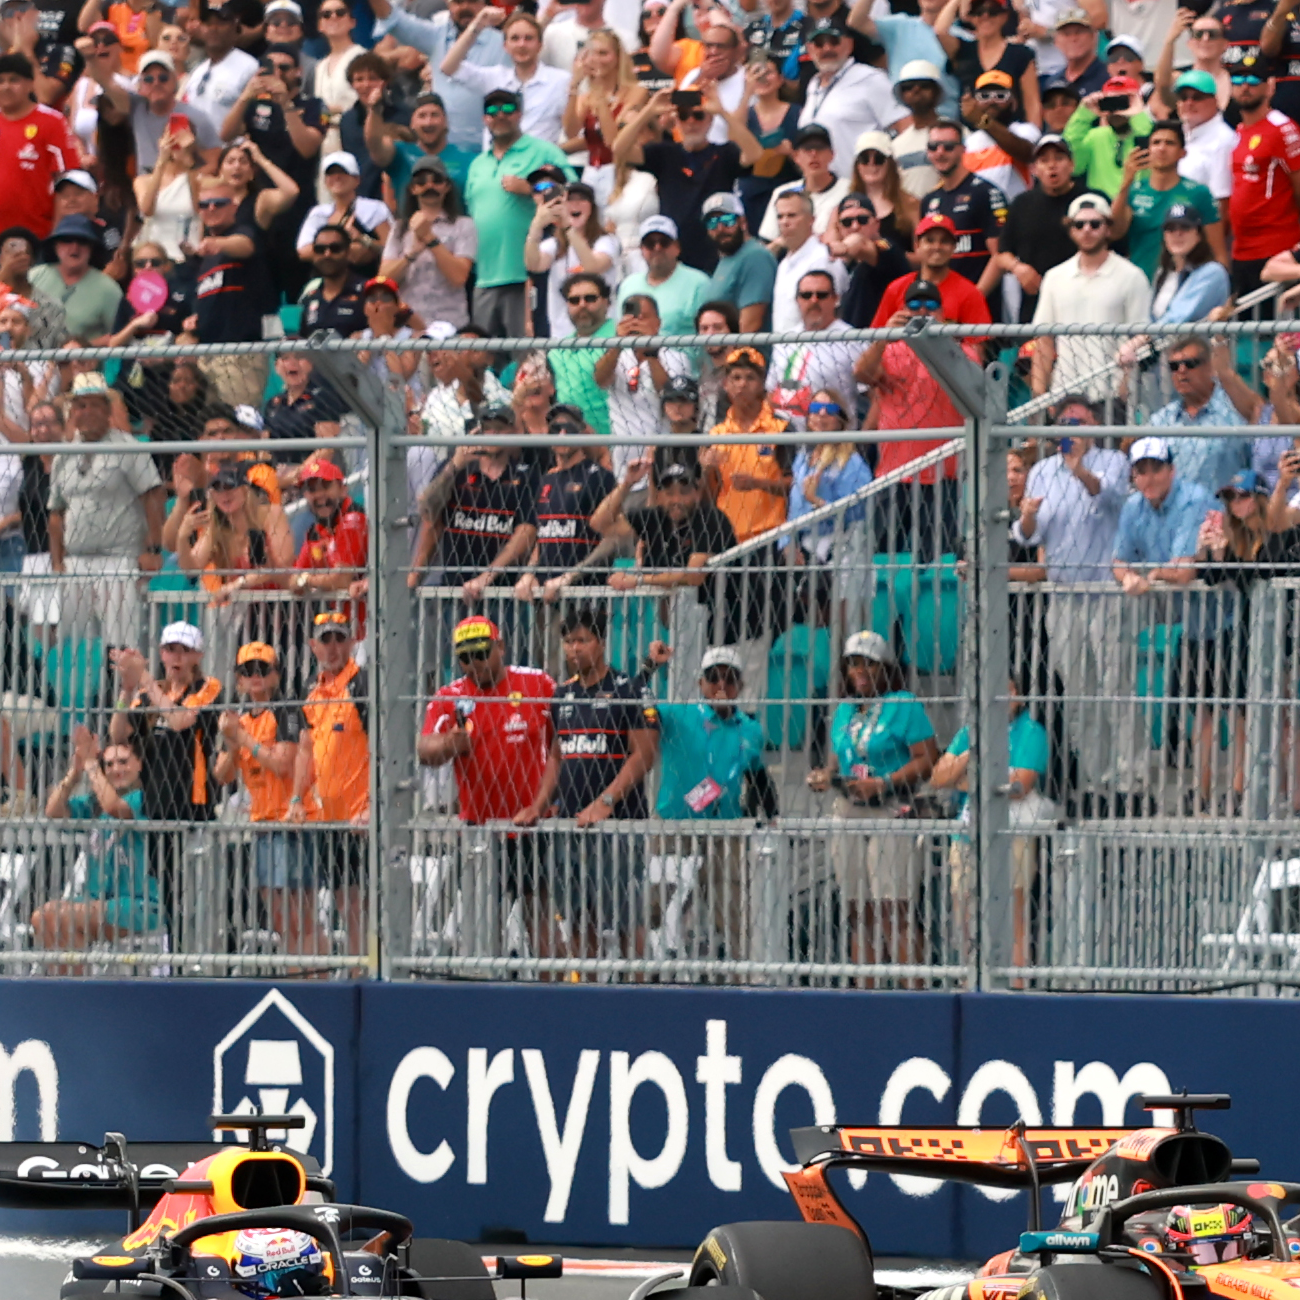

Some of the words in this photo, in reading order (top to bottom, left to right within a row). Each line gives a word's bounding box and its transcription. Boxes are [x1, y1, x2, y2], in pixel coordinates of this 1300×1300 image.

[454, 512, 486, 531] Red
[576, 734, 607, 754] Bull
[386, 1019, 1175, 1225] crypto.com
[1026, 1139, 1117, 1158] OK
[1046, 1233, 1090, 1248] allwyn
[266, 1248, 281, 1257] Red
[282, 1245, 296, 1254] Bull
[257, 1256, 309, 1273] ORACLE
[1215, 1272, 1250, 1294] RICHARD
